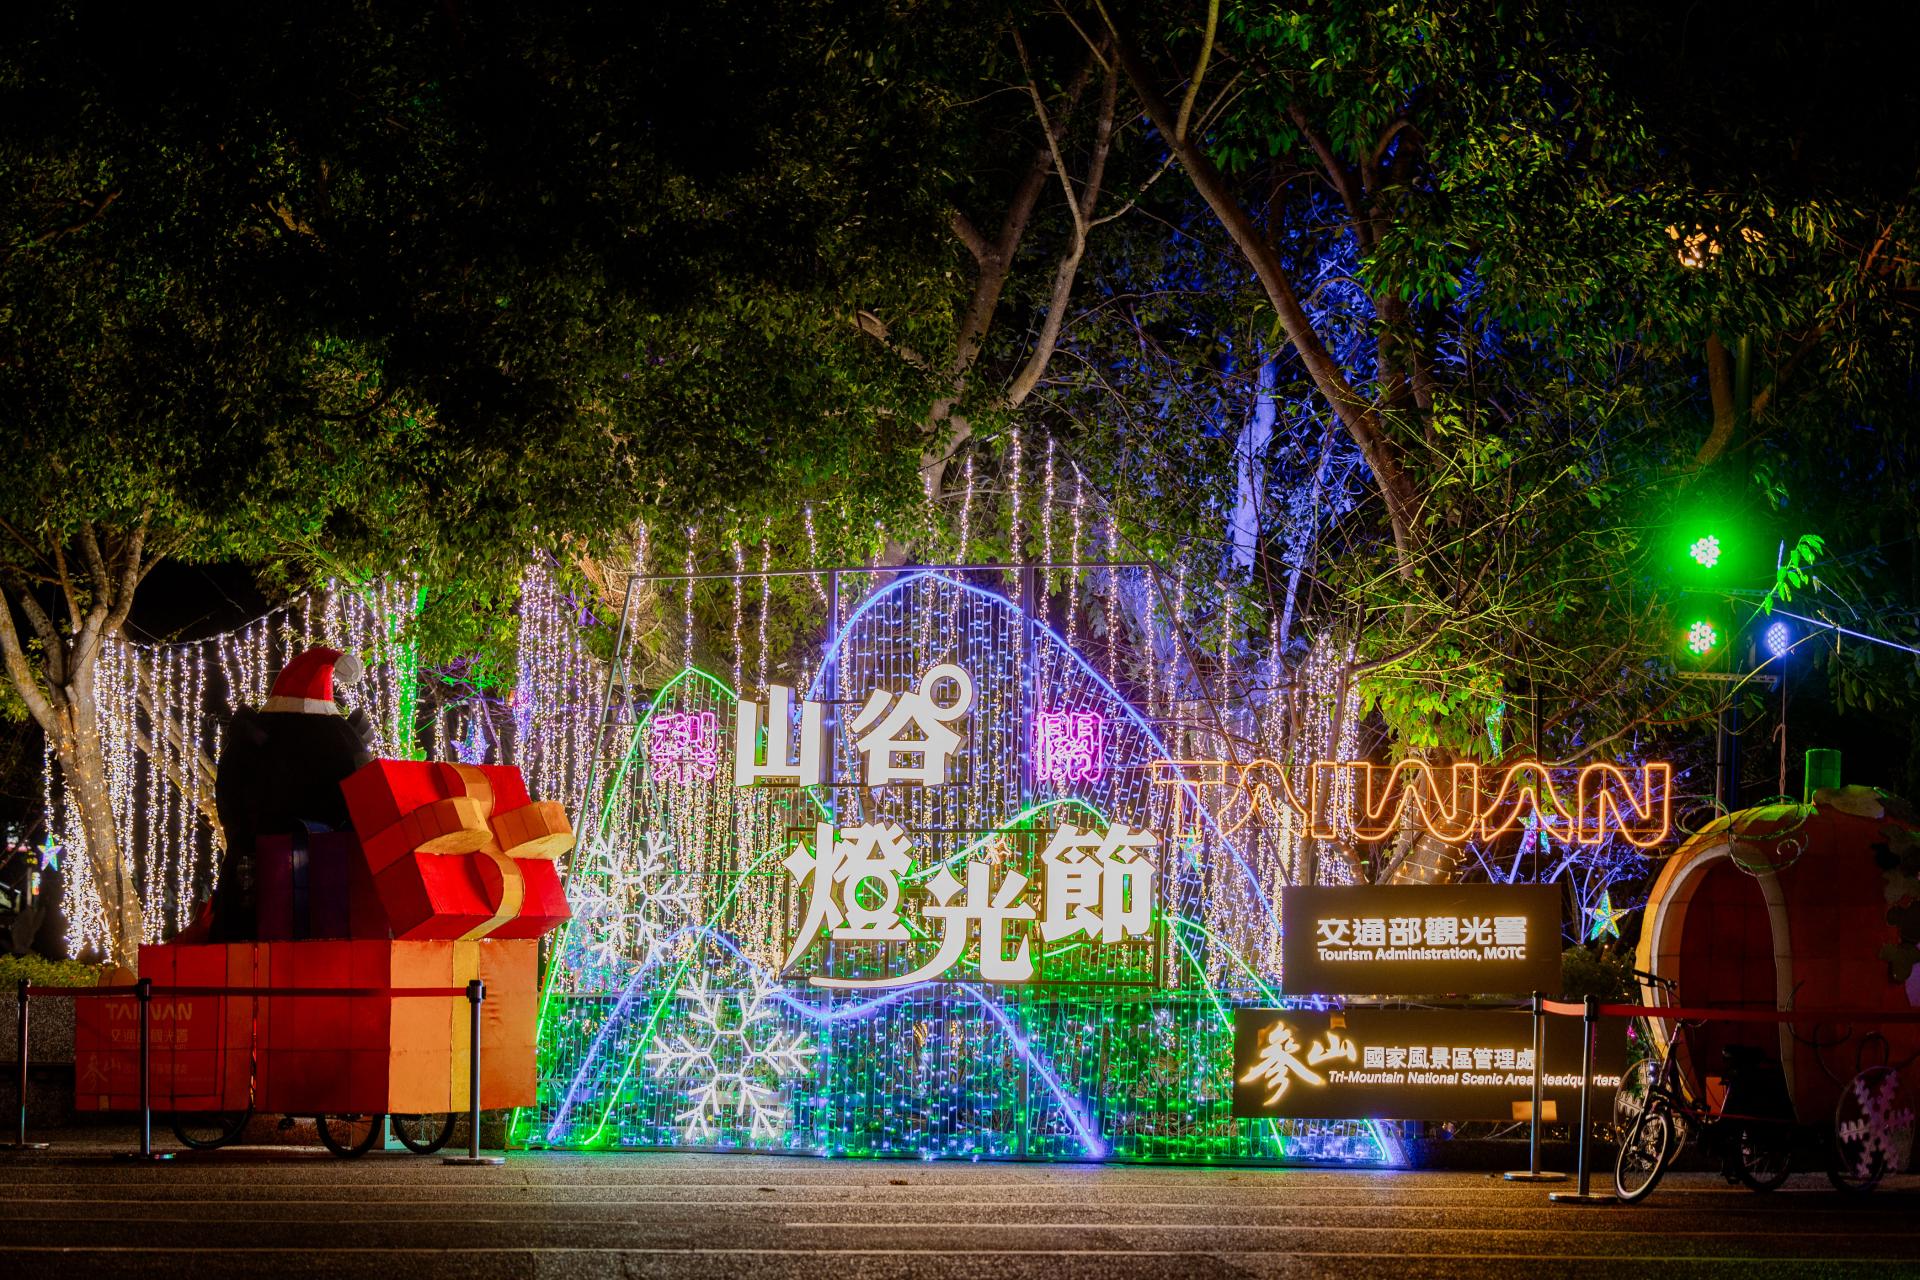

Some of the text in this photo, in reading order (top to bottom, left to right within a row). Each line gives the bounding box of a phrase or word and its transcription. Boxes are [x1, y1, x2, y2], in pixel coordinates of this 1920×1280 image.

[735, 664, 973, 787] 山谷
[1153, 759, 1671, 847] TAIWAN
[781, 822, 1160, 987] 燈光節
[1317, 917, 1527, 946] 交通部觀光署
[1317, 946, 1527, 962] Tourism Administration, MOTC
[1328, 1070, 1622, 1088] Tri-Mountain National Scenic Area Headqurters
